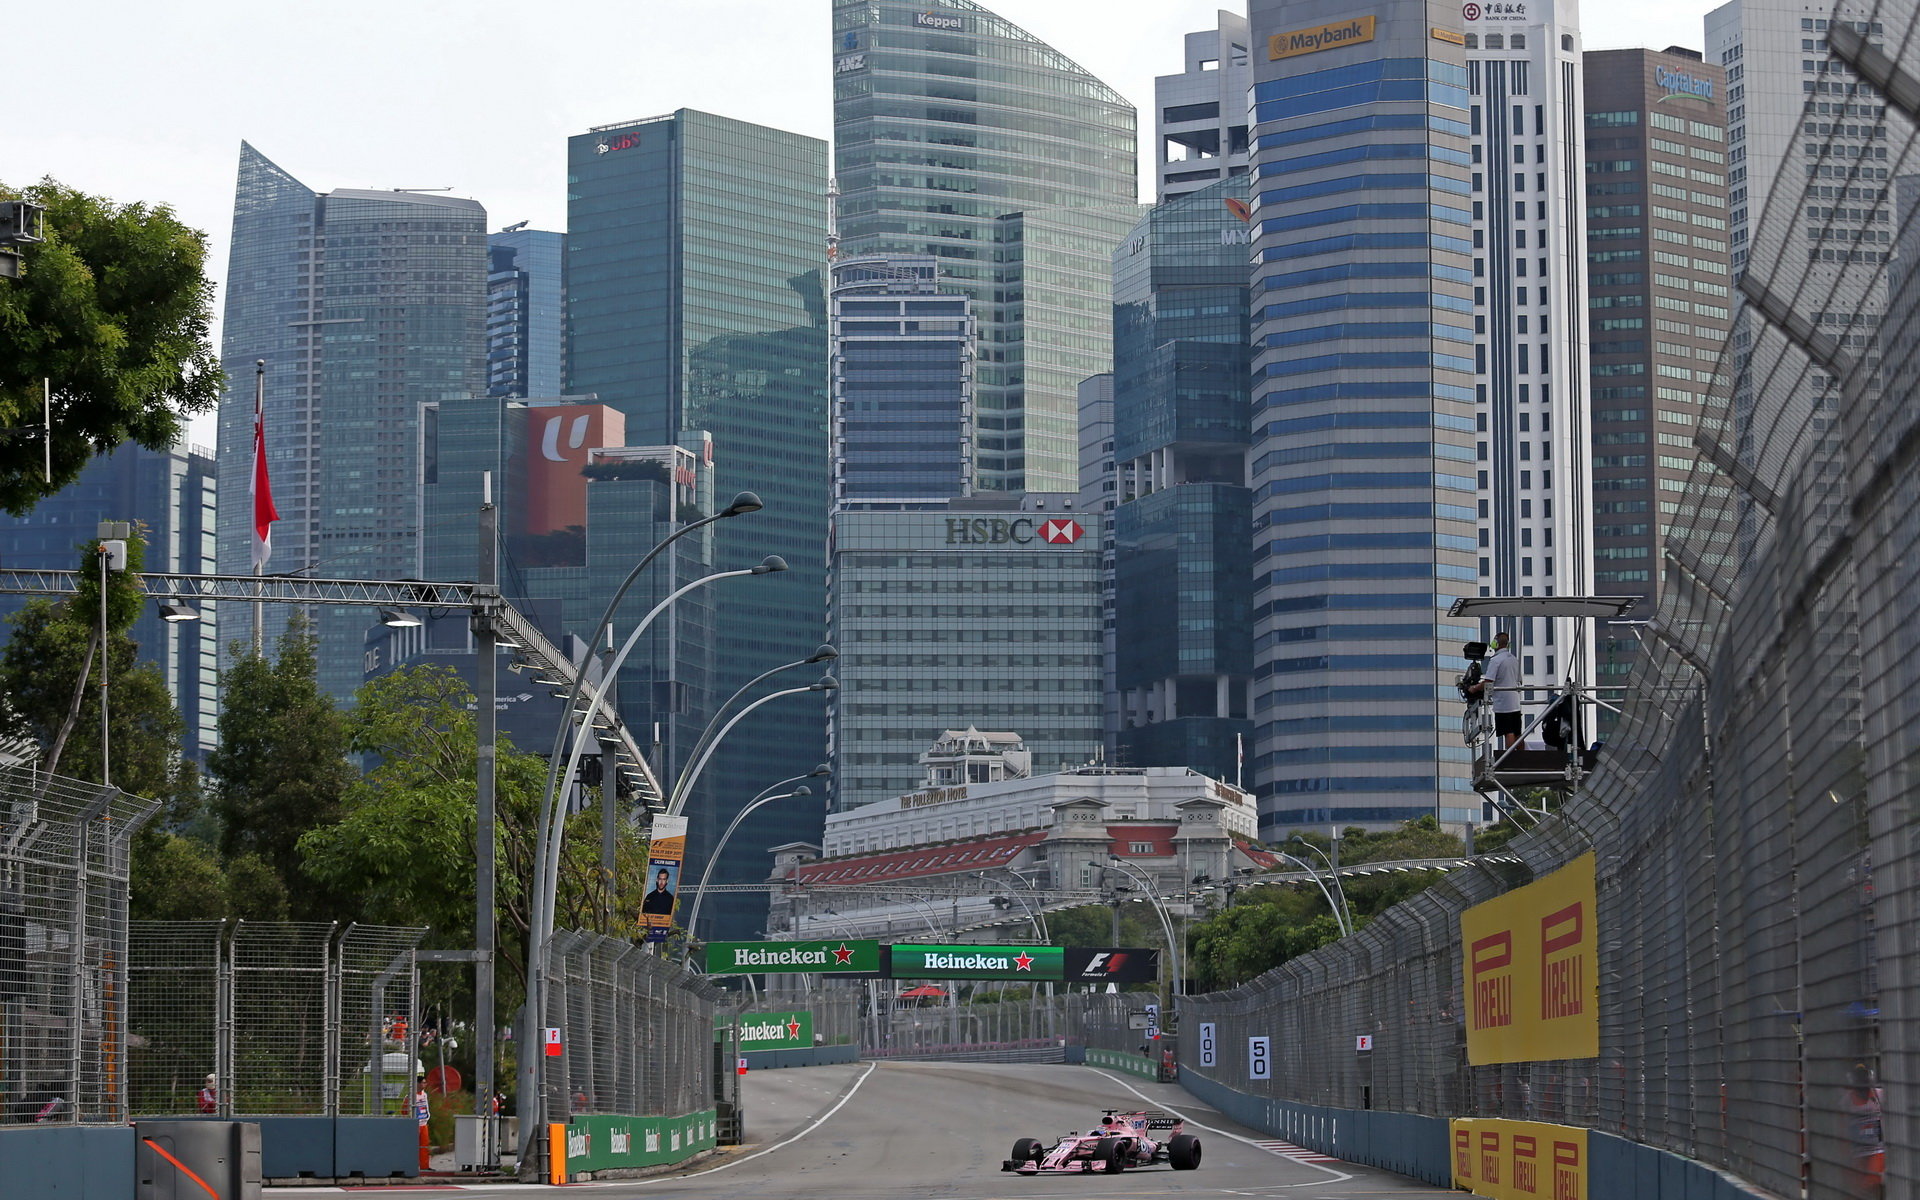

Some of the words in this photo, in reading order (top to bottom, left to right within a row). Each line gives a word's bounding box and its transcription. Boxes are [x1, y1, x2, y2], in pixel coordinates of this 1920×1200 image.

[917, 13, 962, 28] Keppel
[1290, 21, 1362, 50] Maybank
[836, 55, 865, 73] ANZ
[1655, 65, 1713, 98] CapitaLand
[611, 131, 641, 150] UBS
[1127, 236, 1144, 256] MYP
[1221, 229, 1250, 245] MY
[945, 518, 1034, 545] HSBC
[901, 796, 912, 809] THE
[912, 789, 946, 807] FULLERTON
[947, 786, 968, 801] HOTEL
[734, 948, 827, 966] Heineken
[924, 953, 1009, 970] Heineken
[1542, 901, 1583, 1020] PIRELLI
[1472, 930, 1512, 1031] PIRELLI
[551, 1030, 557, 1041] F
[1203, 1026, 1212, 1064] 100
[1360, 1038, 1366, 1048] F
[1253, 1041, 1266, 1075] 50
[1456, 1130, 1472, 1178] PIRELLI
[1481, 1132, 1499, 1184] PIRELLI
[1513, 1135, 1536, 1194] PIRELLI
[1554, 1141, 1579, 1200] PIRELLI
